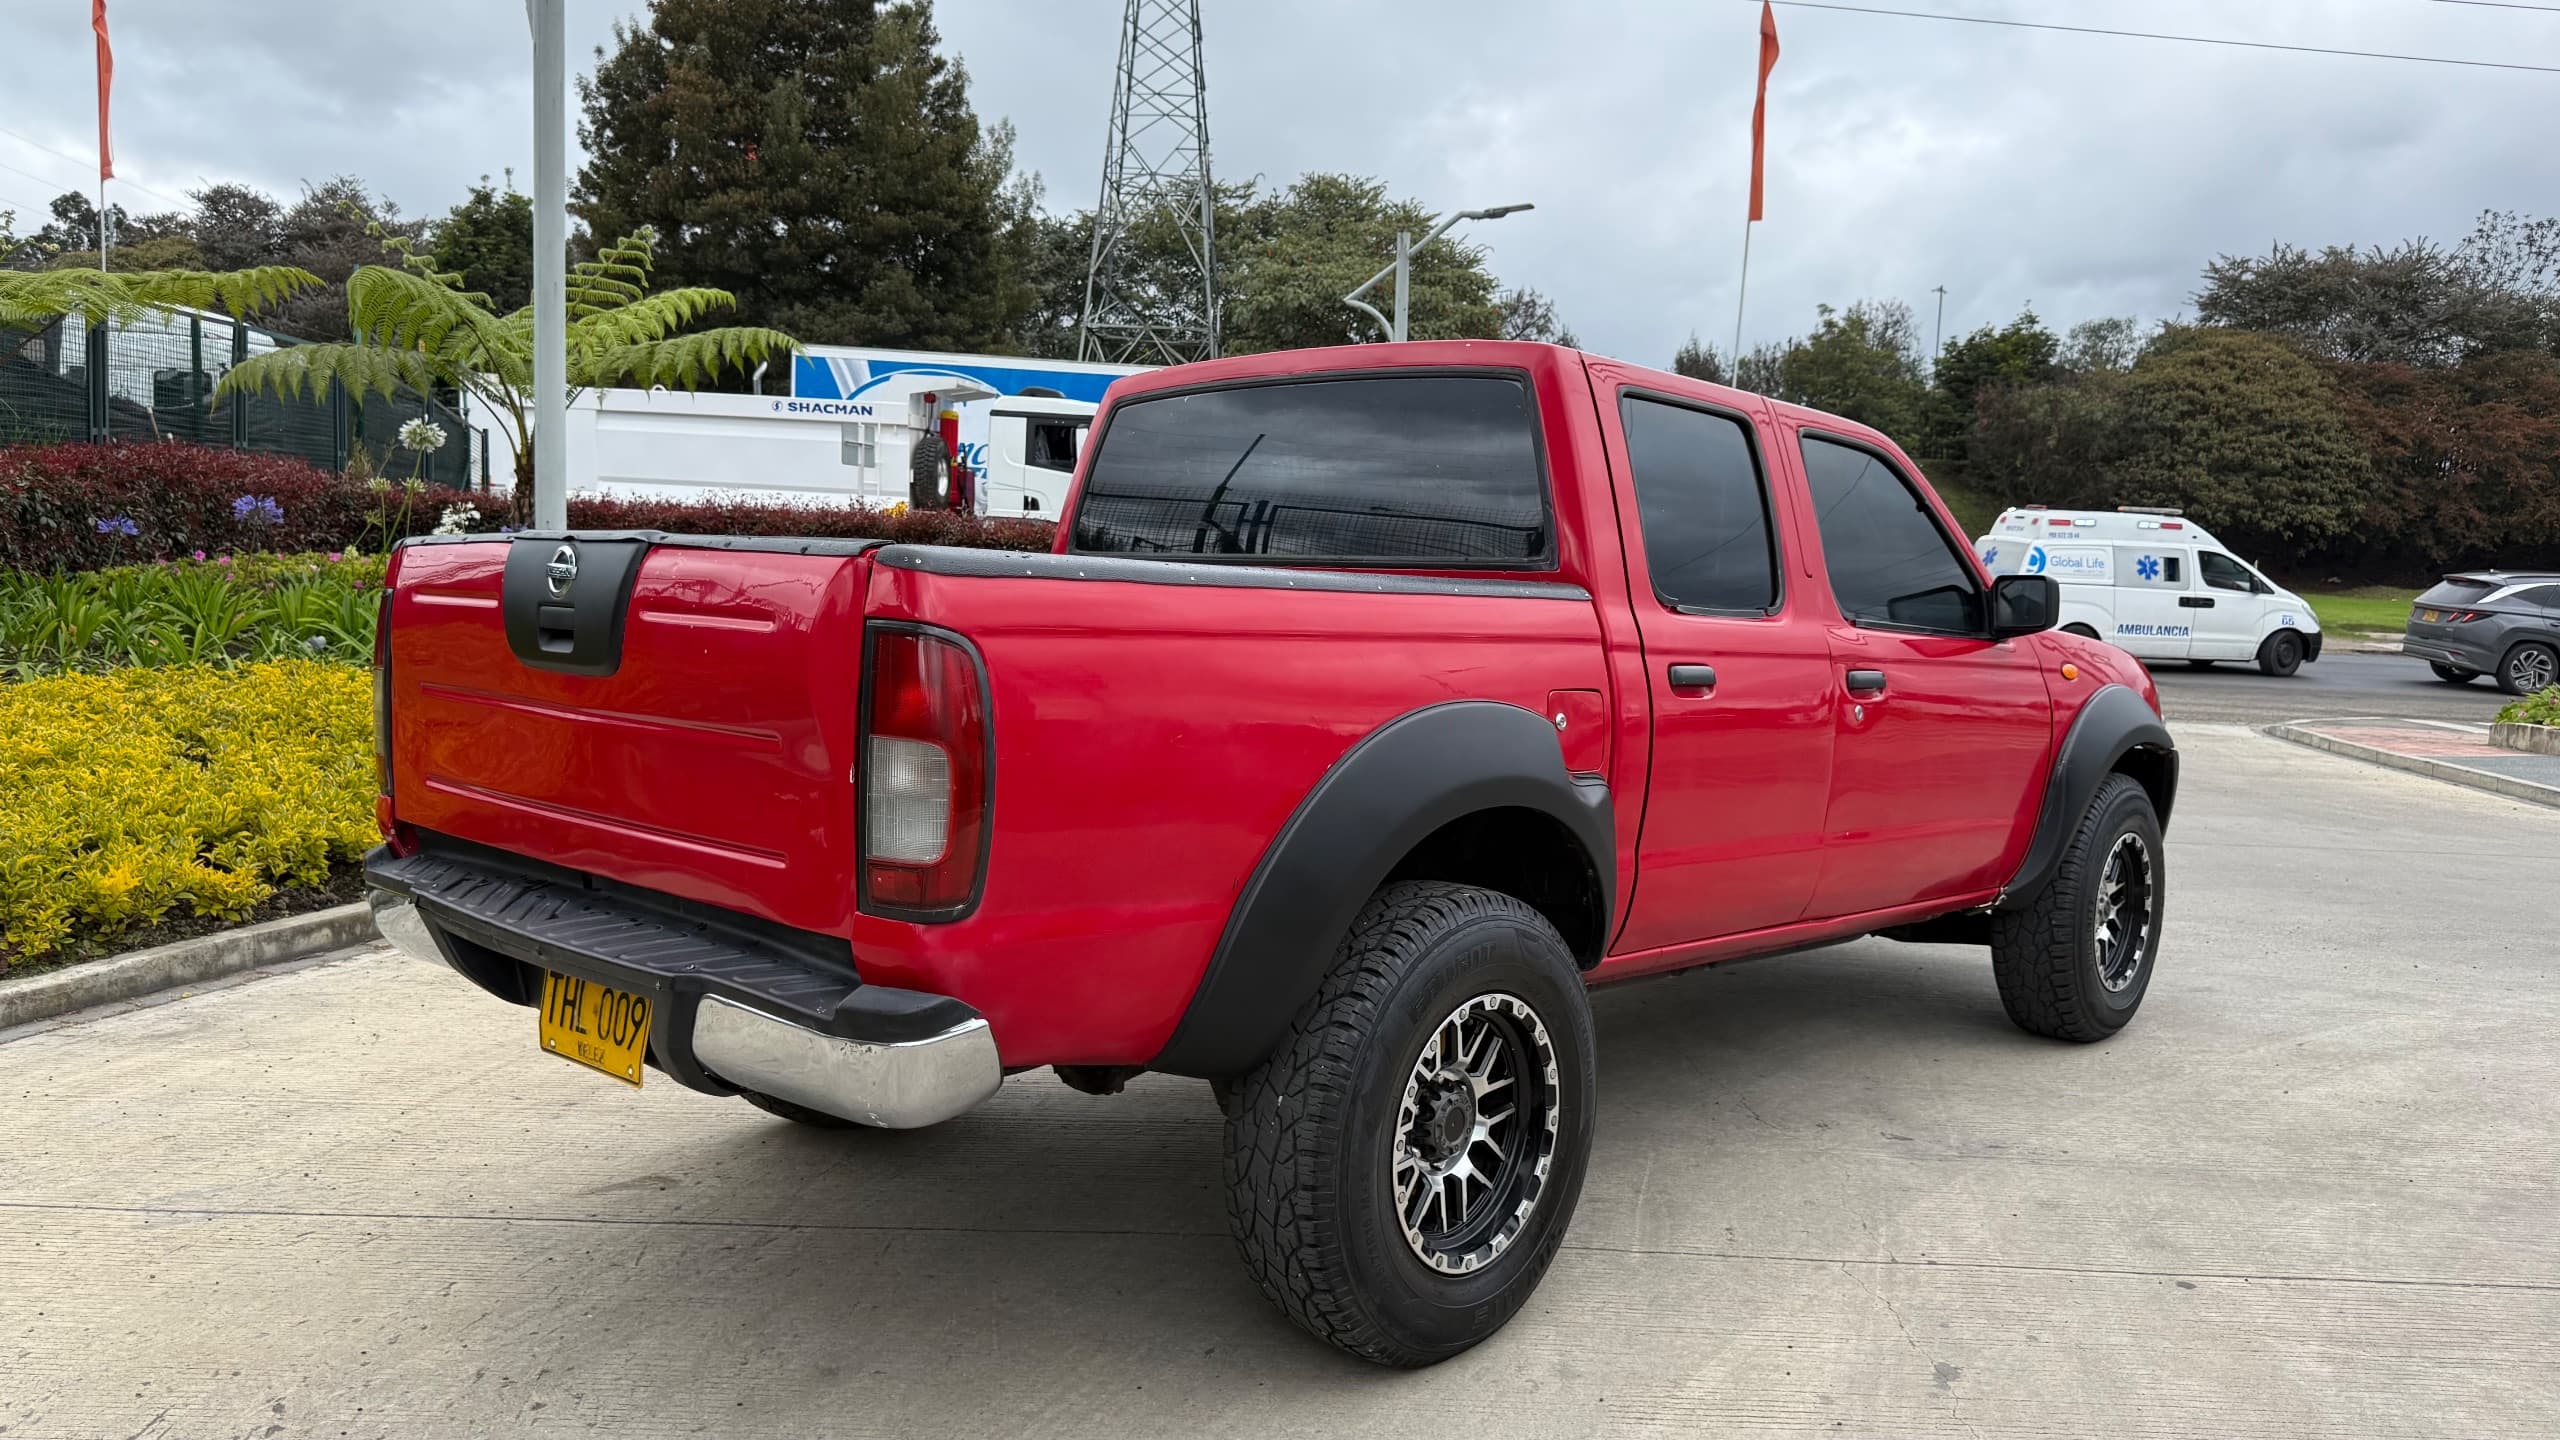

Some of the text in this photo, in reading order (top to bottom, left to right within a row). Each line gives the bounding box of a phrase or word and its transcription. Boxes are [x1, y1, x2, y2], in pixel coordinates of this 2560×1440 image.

[787, 402, 873, 416] SHACMAN
[2050, 555, 2105, 569] Global Life
[2117, 623, 2189, 637] AMBULANCIA
[548, 970, 647, 1051] THL 009
